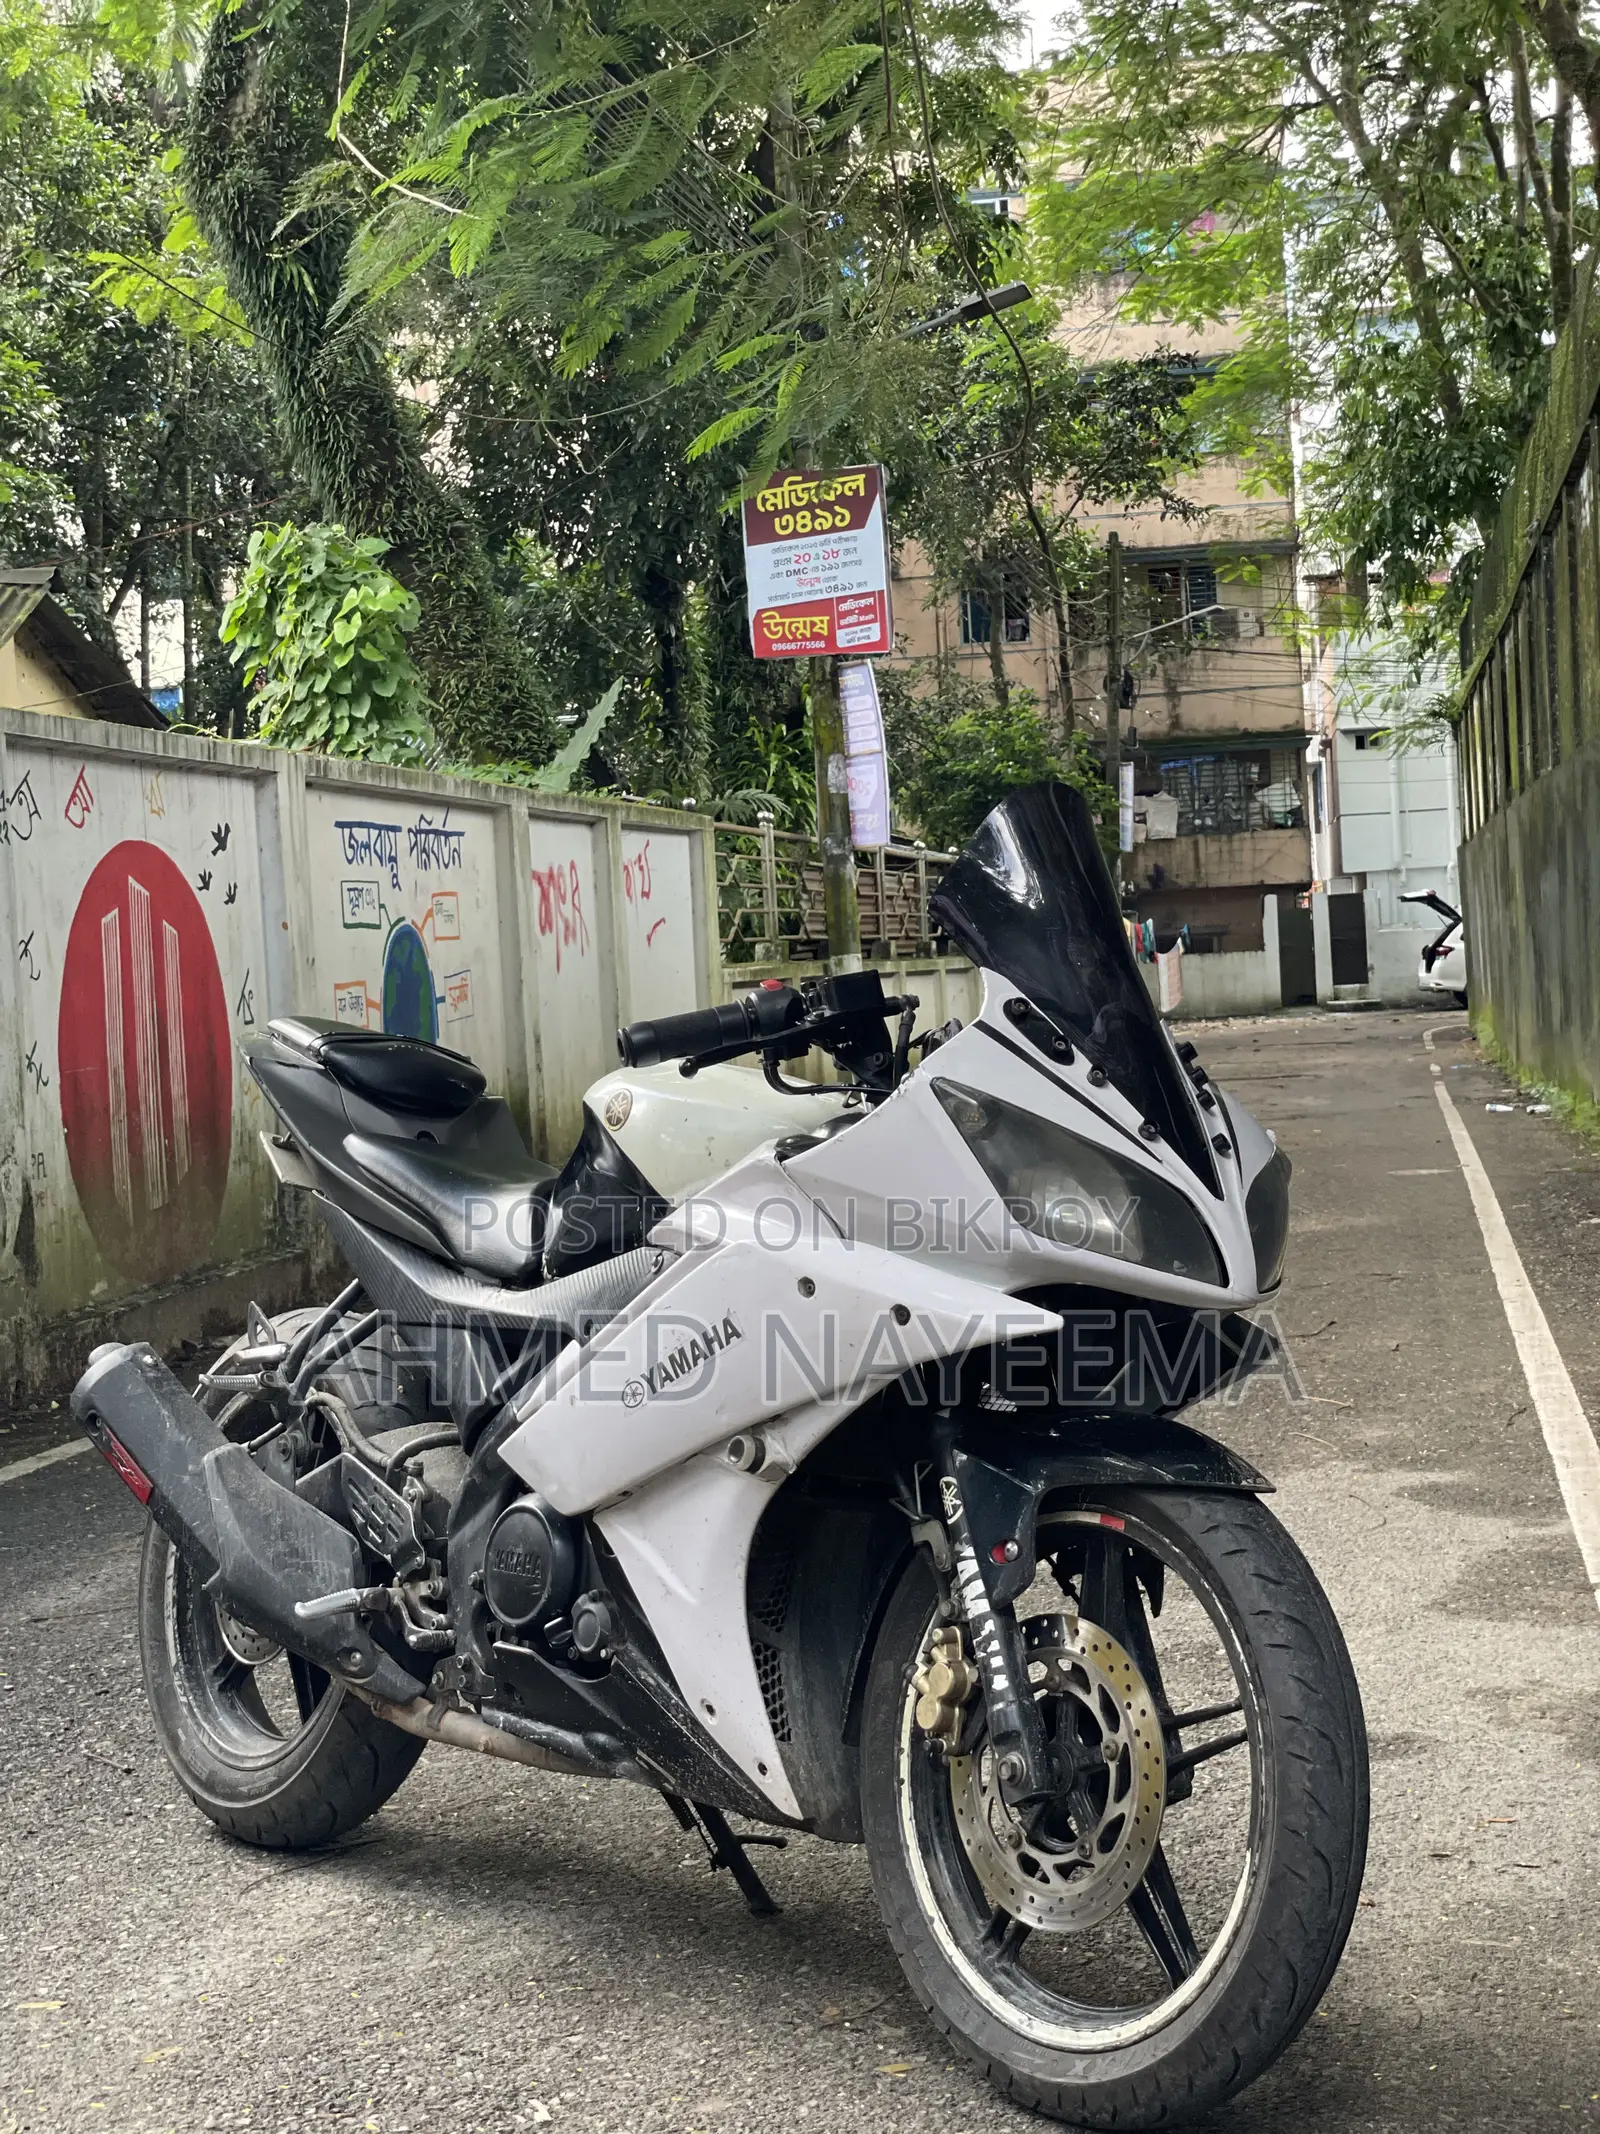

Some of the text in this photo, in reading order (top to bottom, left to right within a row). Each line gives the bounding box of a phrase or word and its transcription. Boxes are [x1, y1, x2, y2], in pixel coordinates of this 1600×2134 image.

[774, 505, 851, 536] ৩৪৯১
[770, 571, 784, 580] এবং
[785, 567, 809, 578] DMC
[820, 562, 840, 572] ১৯১
[773, 547, 858, 568] প্রথম ২০ এ ১৮ জন
[825, 581, 854, 594] ৩৪৯১
[856, 580, 868, 588] জন
[761, 610, 830, 640] উন্মেষ
[772, 640, 825, 651] 09666775566
[334, 806, 466, 892] জলবায়ু পরিবর্তন
[640, 1316, 741, 1394] YAMAHA
[493, 1549, 542, 1578] YAMAHA
